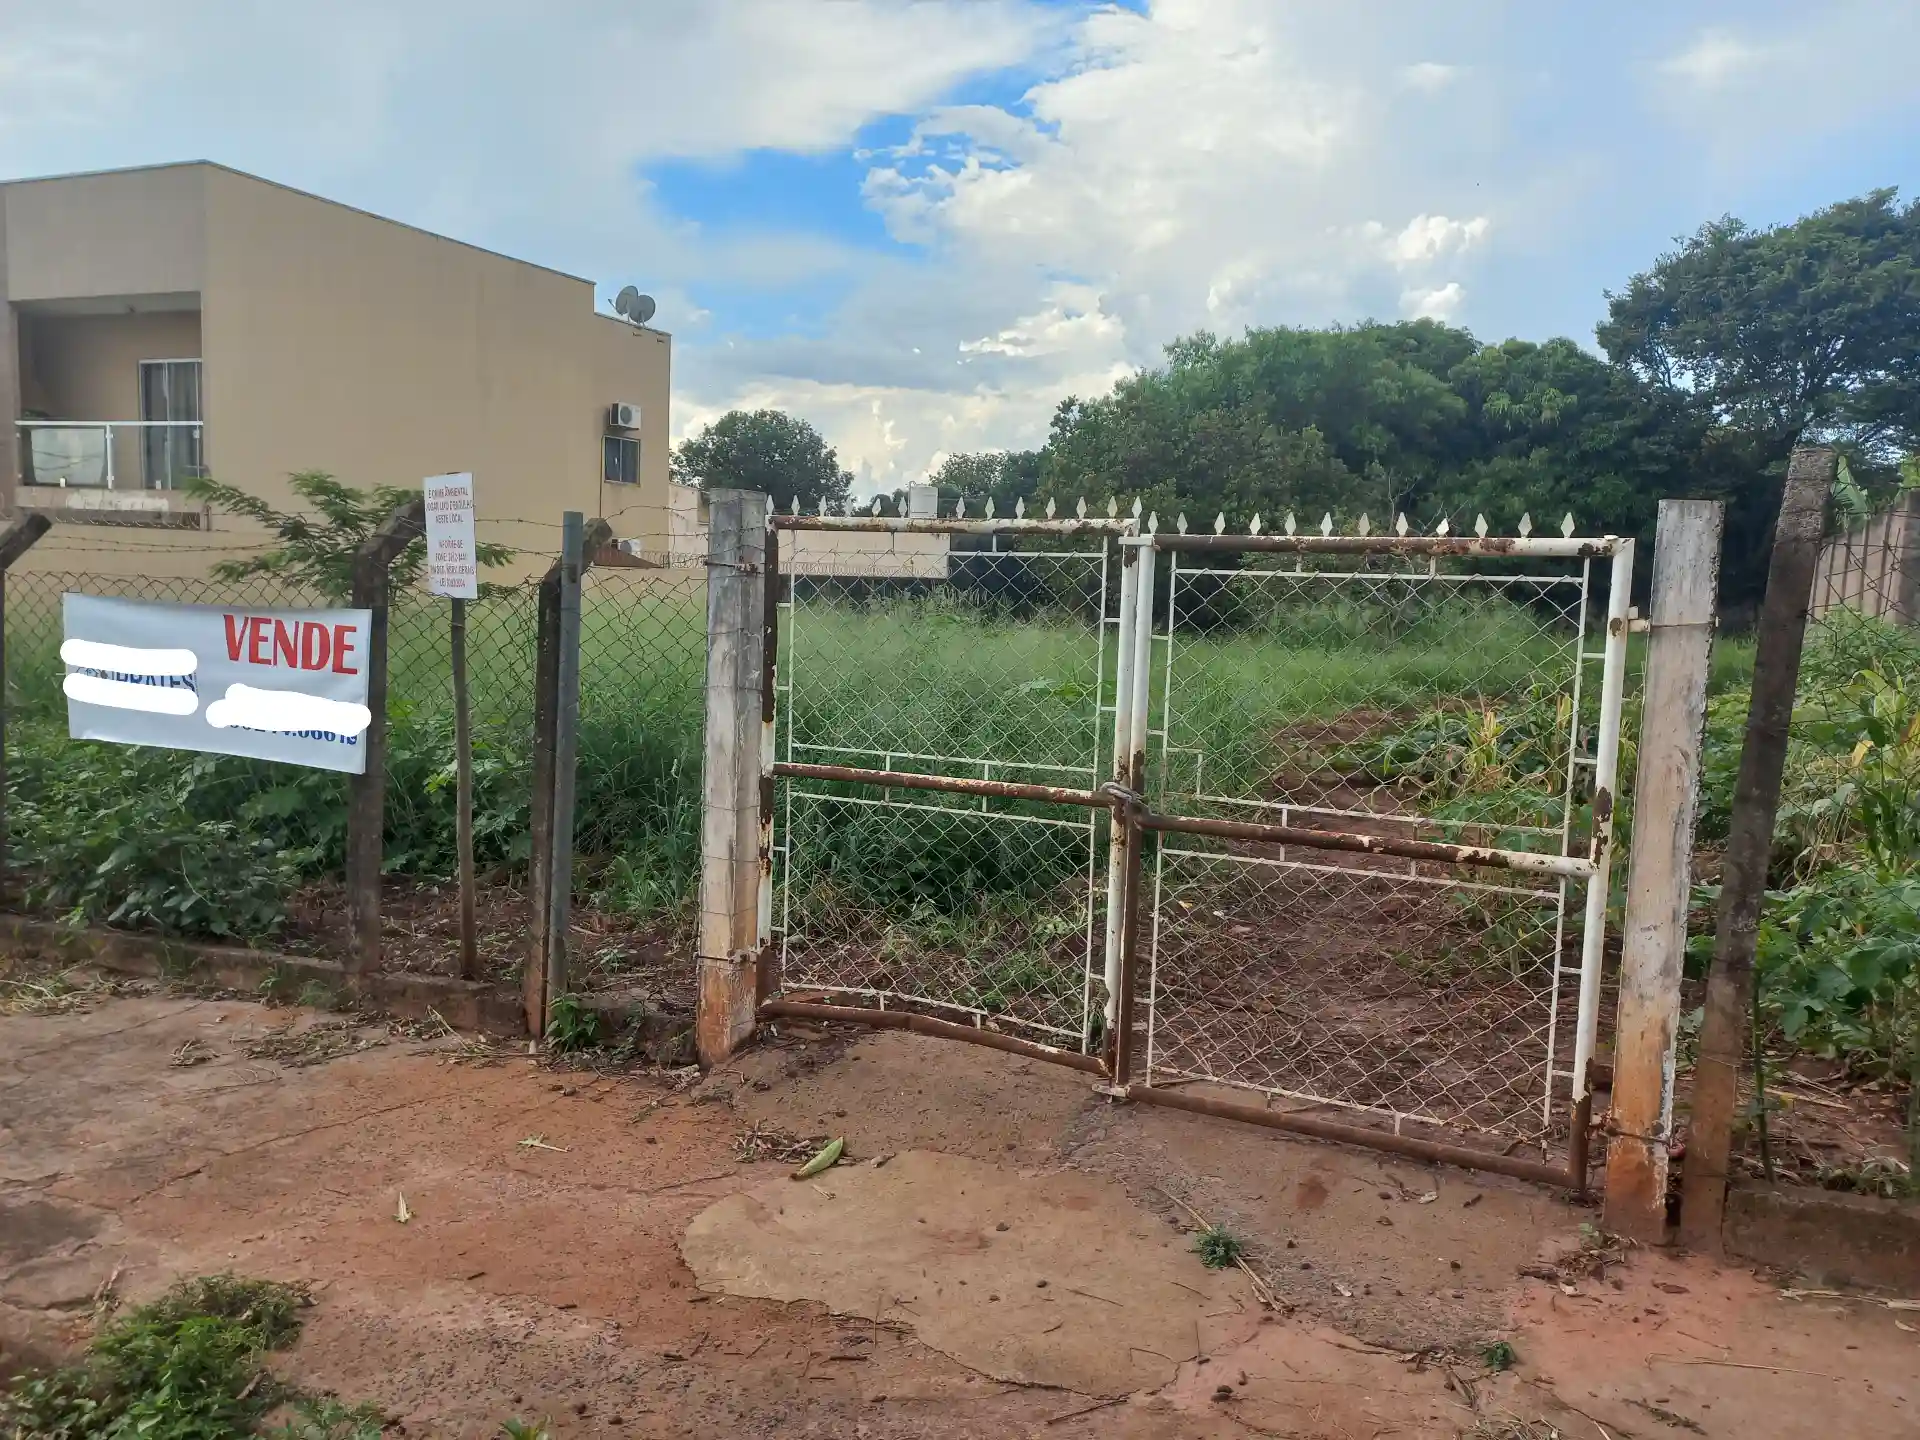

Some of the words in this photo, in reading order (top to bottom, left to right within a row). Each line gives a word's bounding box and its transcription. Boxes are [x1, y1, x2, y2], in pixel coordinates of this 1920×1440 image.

[444, 486, 469, 498] AMBIENTAL
[435, 514, 449, 524] NESTE
[449, 513, 465, 523] LOCAL
[223, 614, 358, 675] VENDE
